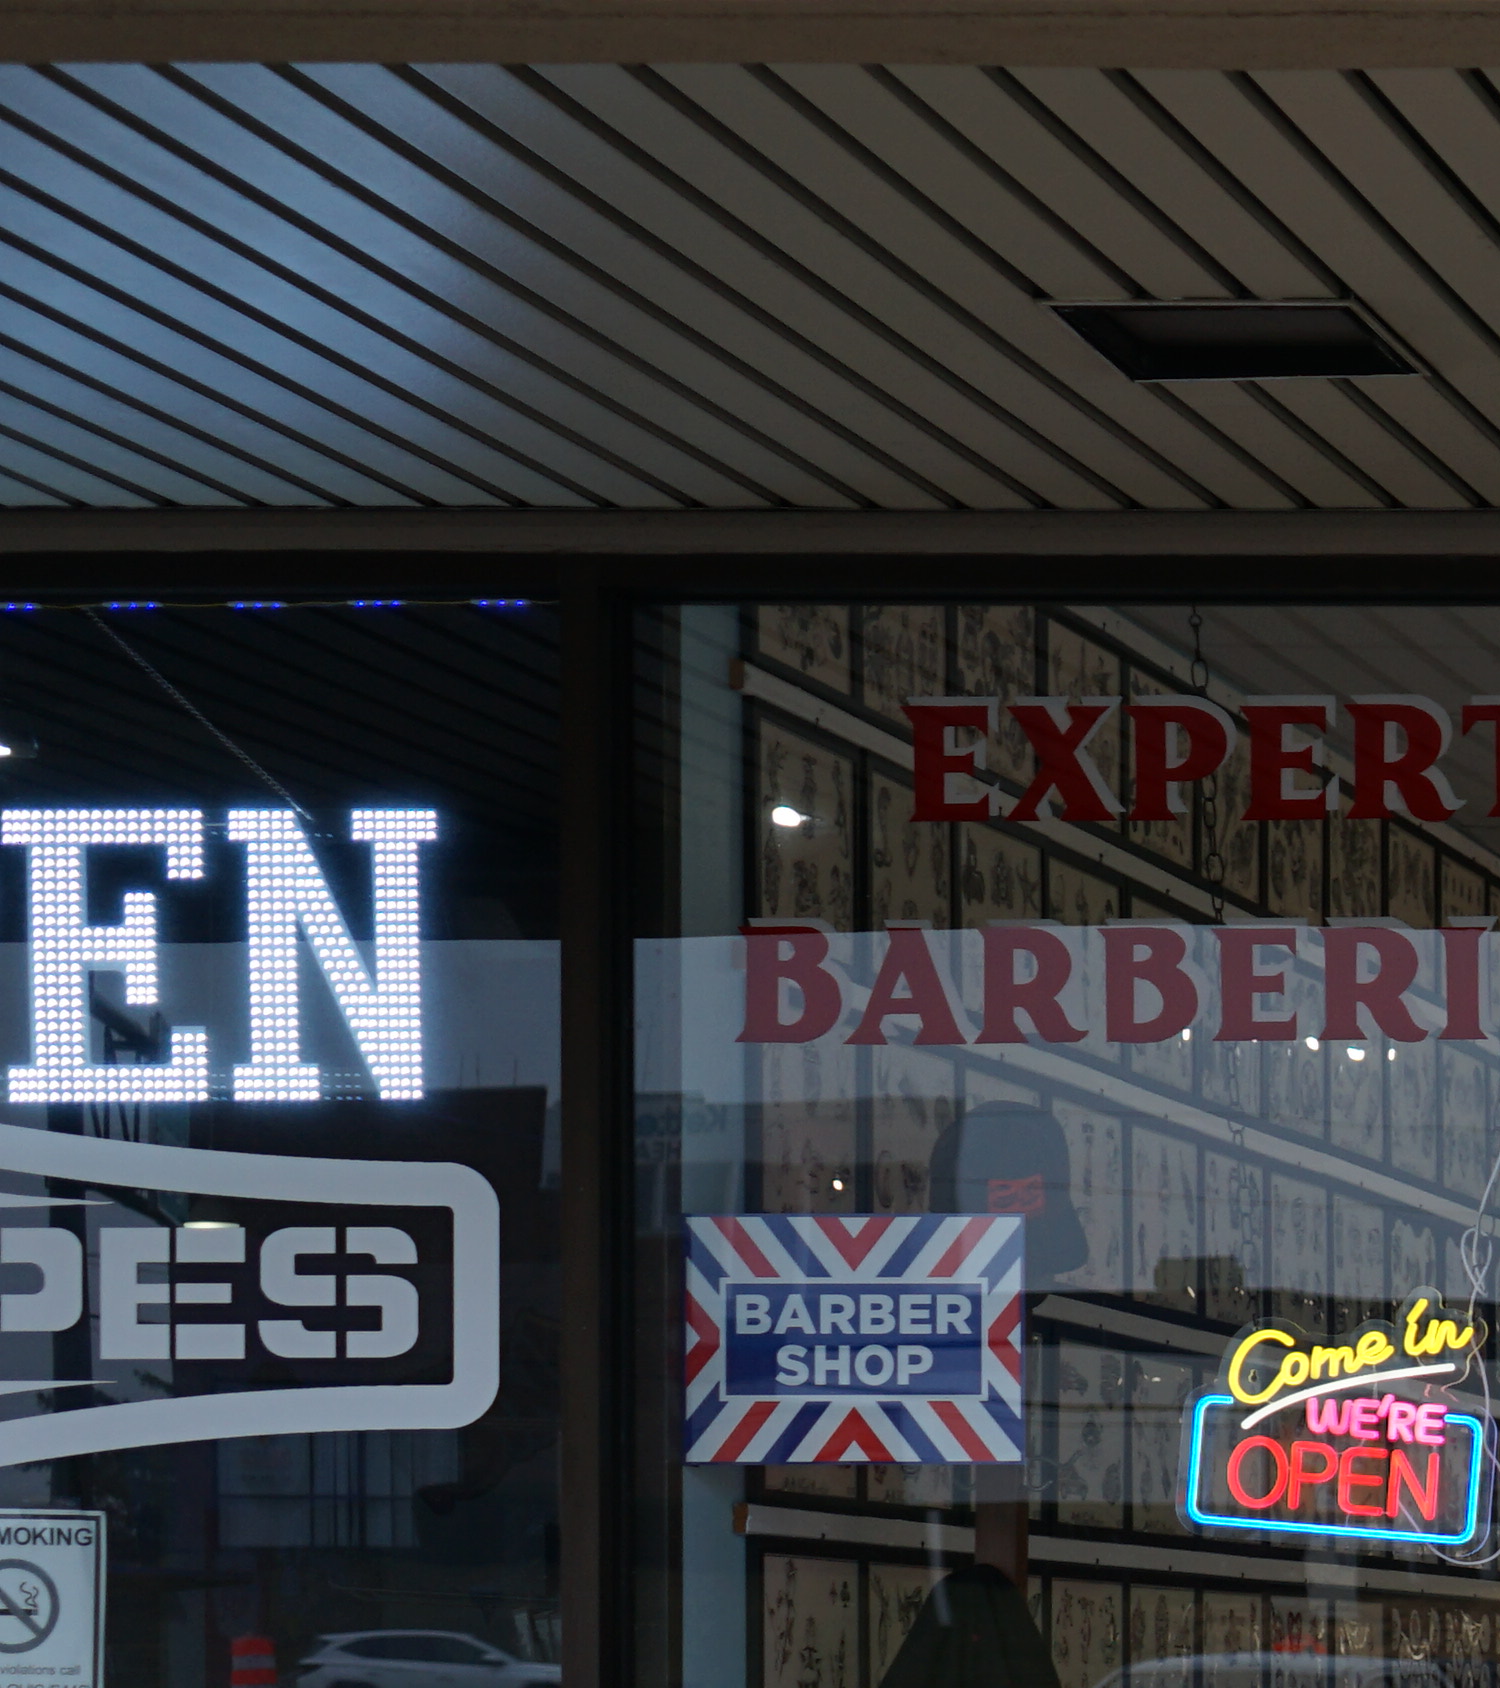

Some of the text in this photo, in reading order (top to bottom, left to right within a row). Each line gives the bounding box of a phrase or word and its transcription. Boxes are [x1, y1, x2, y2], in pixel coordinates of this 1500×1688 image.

[735, 1294, 973, 1335] BARBER
[775, 1344, 934, 1386] SHOP
[1228, 1329, 1393, 1405] Come
[1306, 1394, 1447, 1445] WE'RE
[1226, 1434, 1441, 1521] OPEN
[0, 1665, 56, 1675] violations
